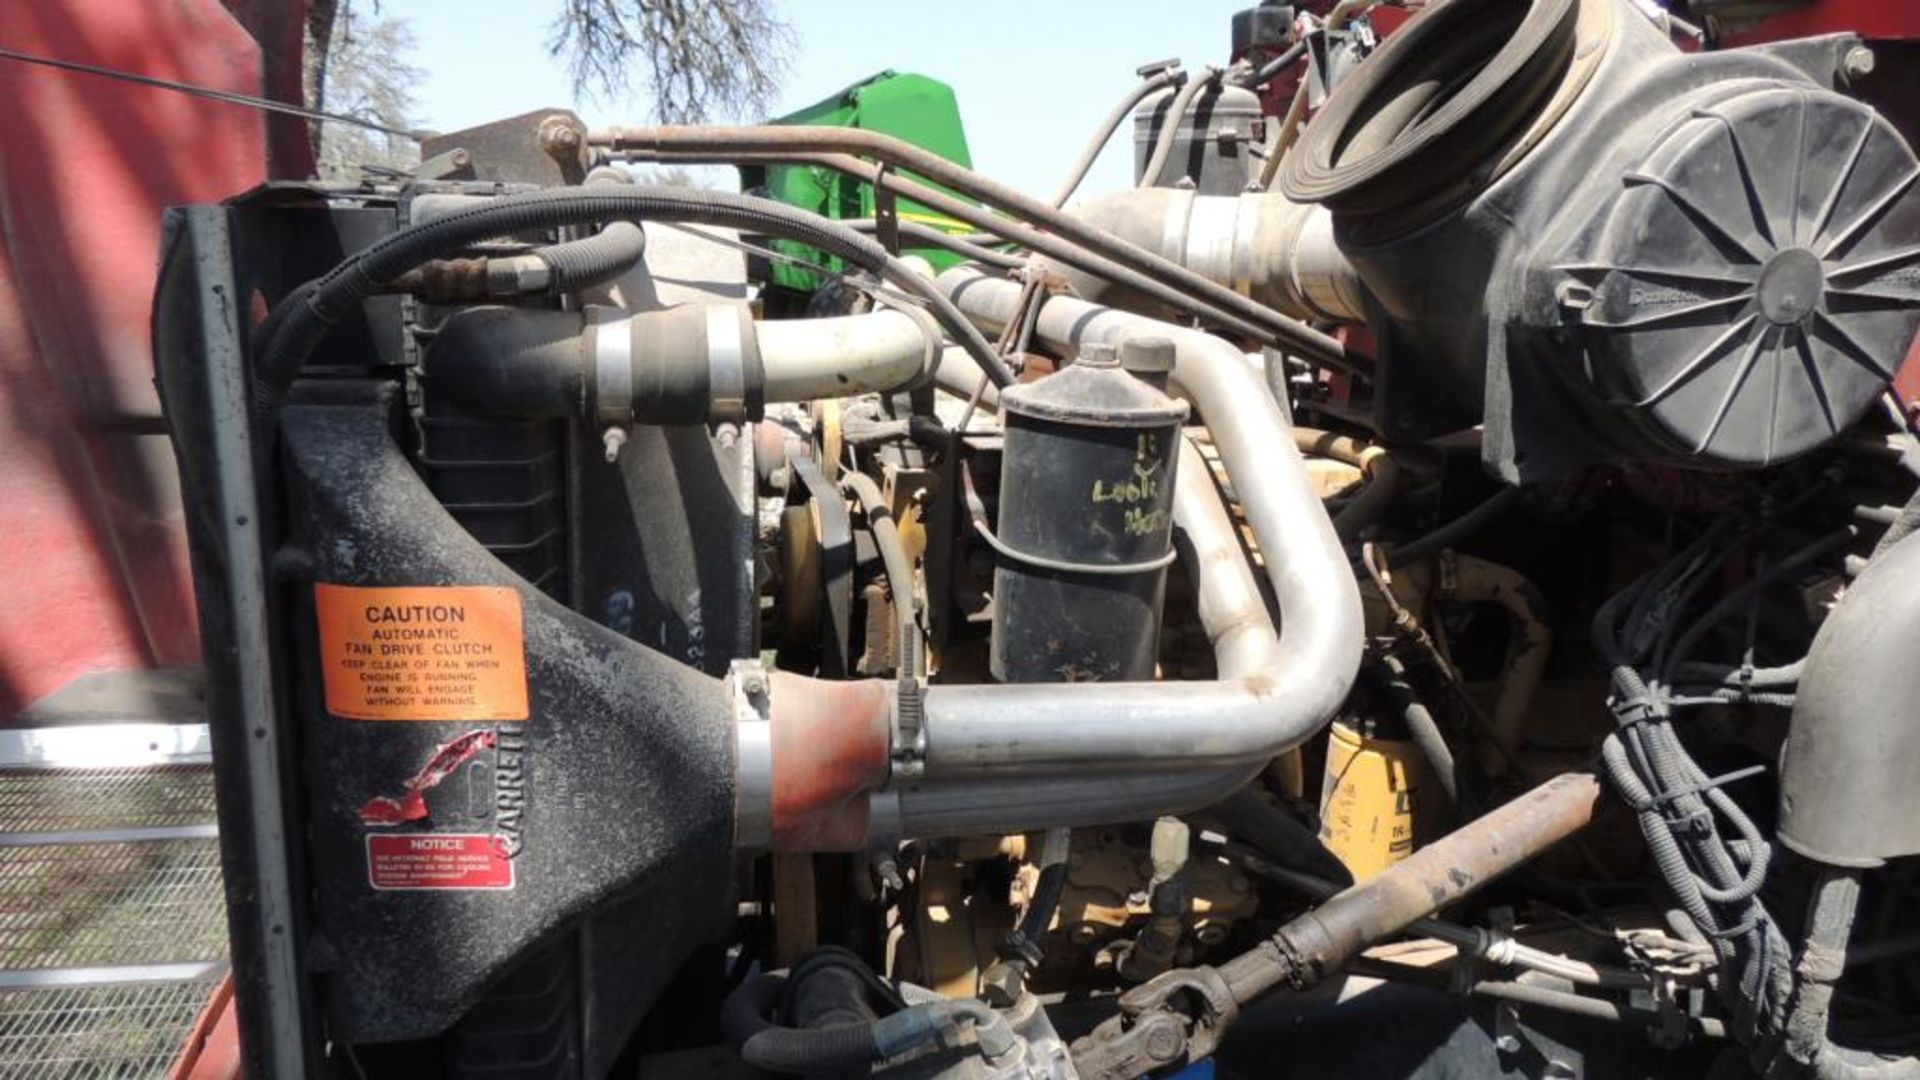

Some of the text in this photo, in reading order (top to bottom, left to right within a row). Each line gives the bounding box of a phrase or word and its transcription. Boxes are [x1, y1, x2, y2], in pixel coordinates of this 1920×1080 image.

[364, 605, 466, 624] CAUTION
[372, 628, 460, 641] AUTOMATIC
[345, 642, 493, 656] FAN DRIVE CLUTCH
[371, 660, 408, 671] CLEAR
[414, 659, 429, 670] OF
[436, 660, 459, 669] FAN
[466, 660, 500, 669] WHEN
[360, 672, 402, 682] ENGINE
[366, 684, 476, 695] FAN WILL ENGAGE
[365, 697, 416, 706] WITHOUT
[494, 726, 524, 860] GARRETT
[410, 839, 465, 850] NOTICE
